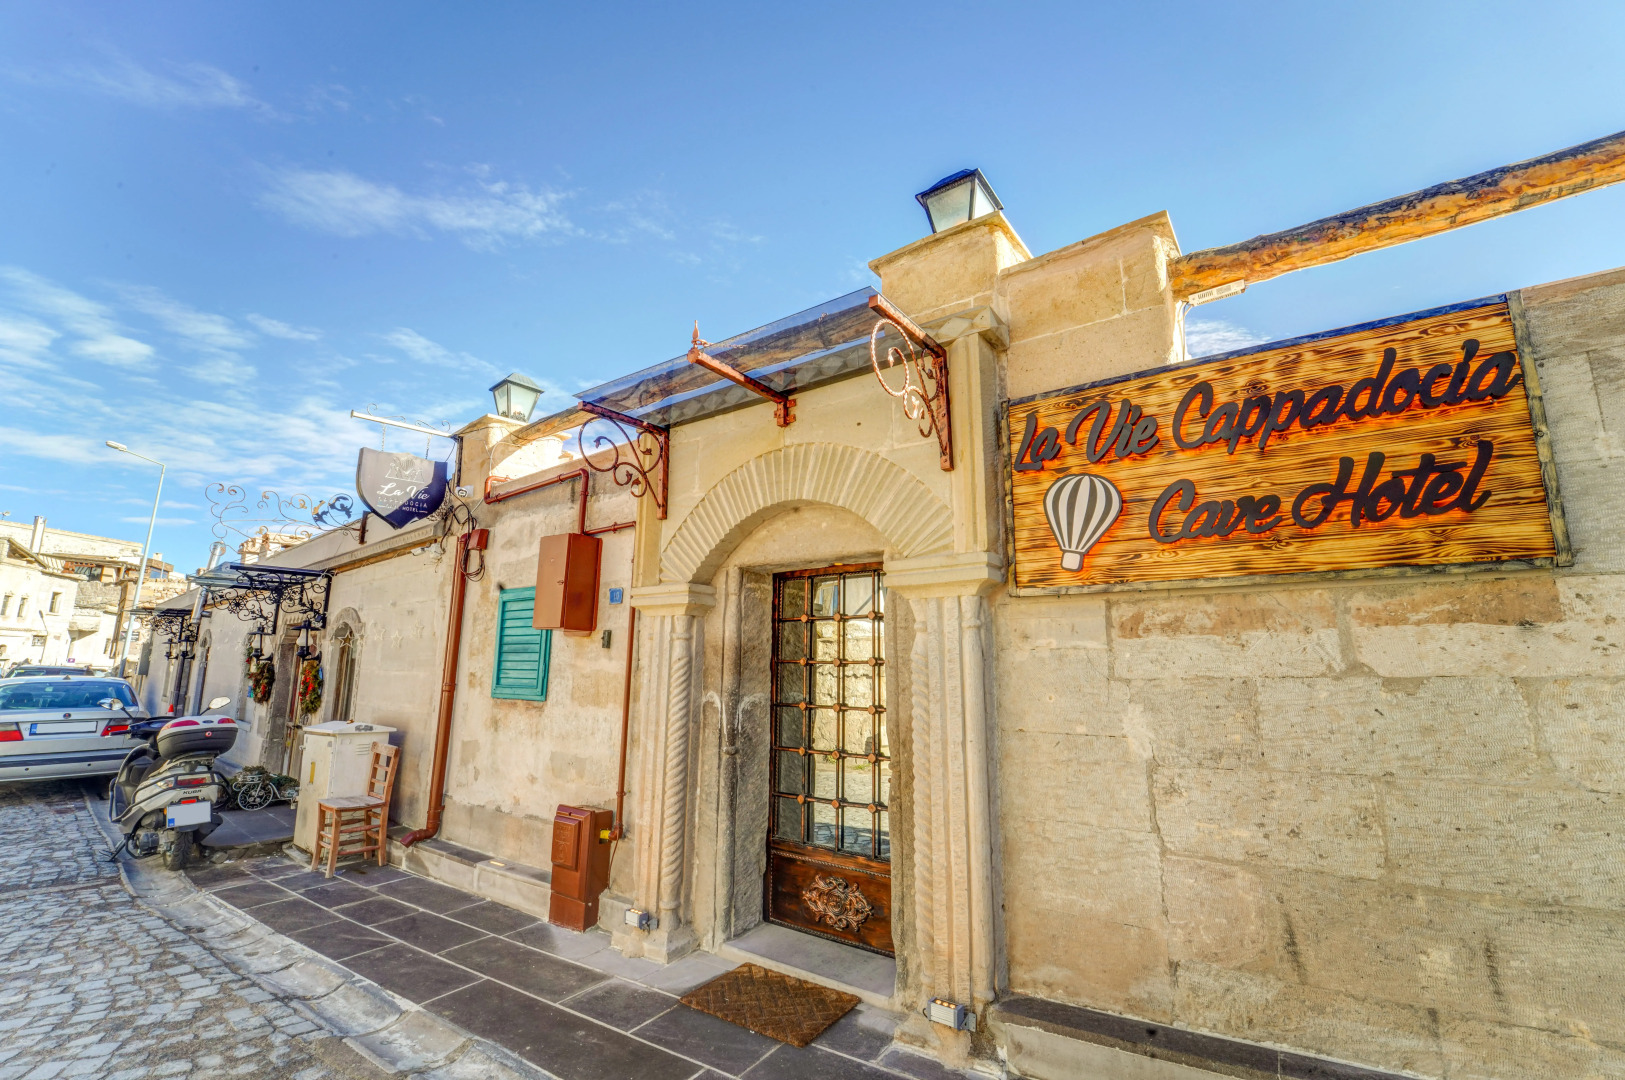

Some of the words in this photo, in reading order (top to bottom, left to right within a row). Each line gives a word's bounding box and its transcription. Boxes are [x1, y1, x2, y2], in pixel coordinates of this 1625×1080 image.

[1014, 413, 1062, 472] La
[1064, 398, 1160, 463] Vie
[1172, 339, 1523, 454] Cappadocia
[376, 482, 404, 497] La
[406, 485, 431, 500] Vie
[377, 496, 428, 509] DOCIA
[1148, 478, 1282, 544] Cave
[1291, 440, 1493, 529] Hotel
